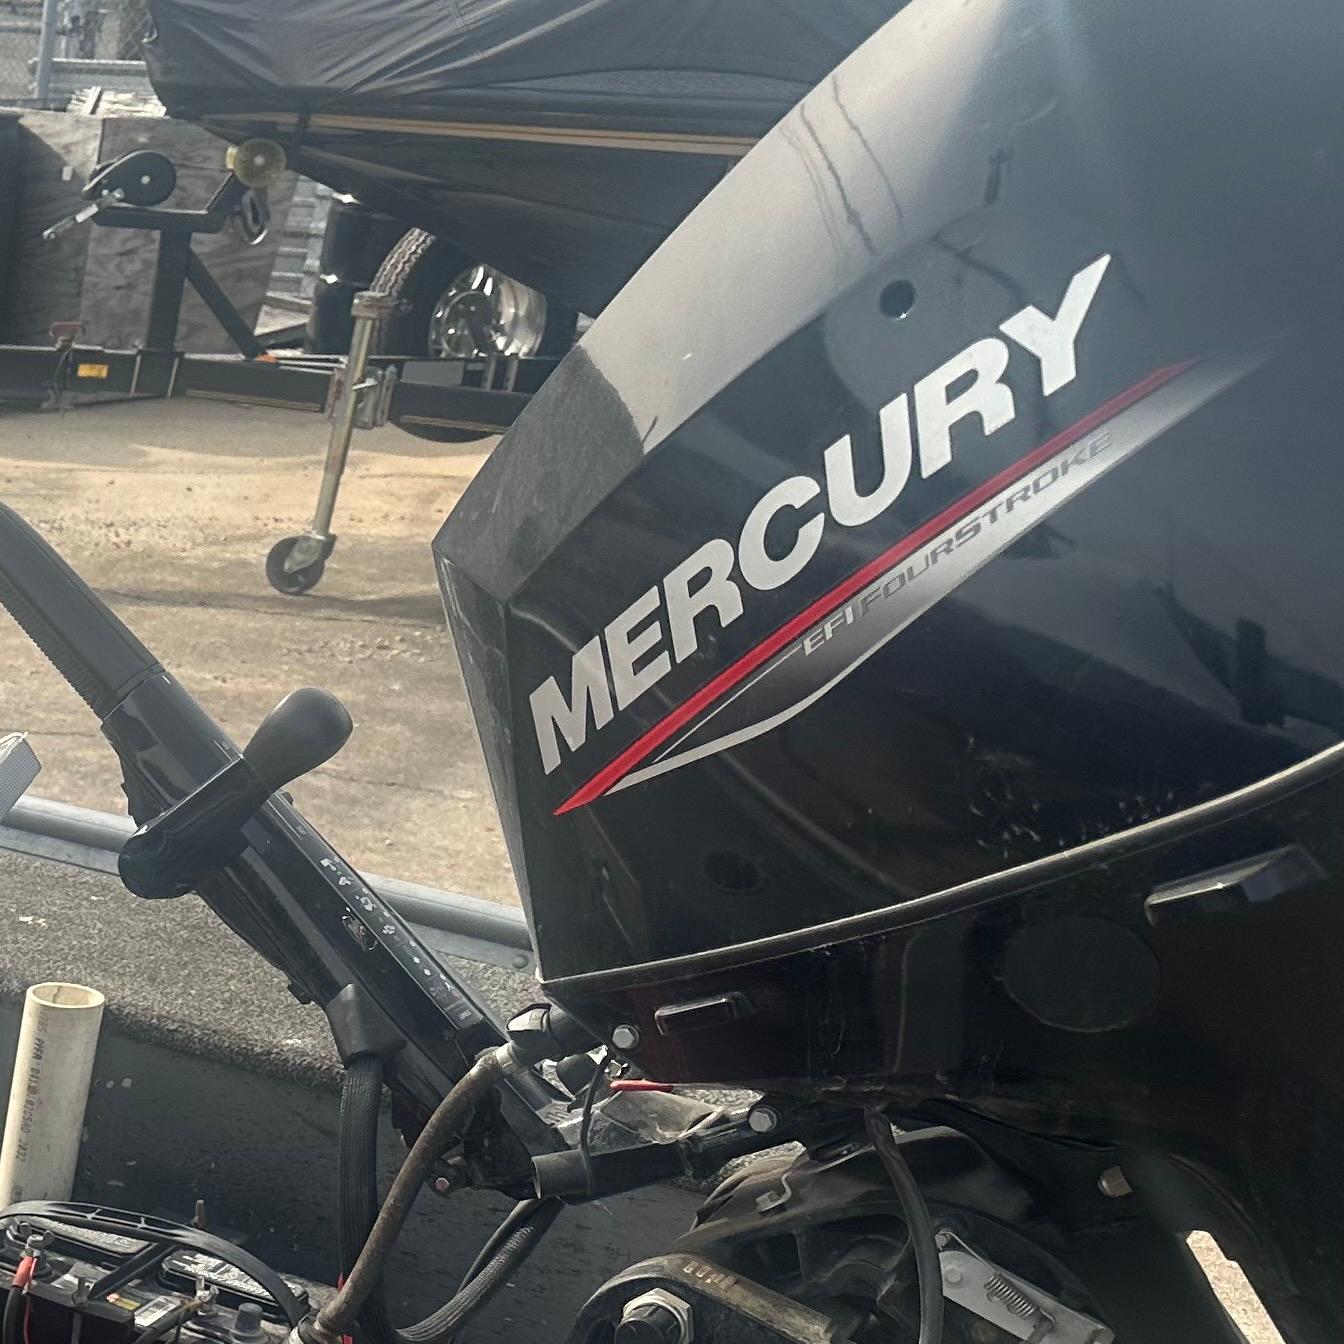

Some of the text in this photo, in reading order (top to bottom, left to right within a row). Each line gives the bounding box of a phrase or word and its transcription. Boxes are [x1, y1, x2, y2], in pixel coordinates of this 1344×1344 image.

[529, 252, 1112, 775] MERCURY
[802, 430, 1114, 656] EFI FOURSTROKE
